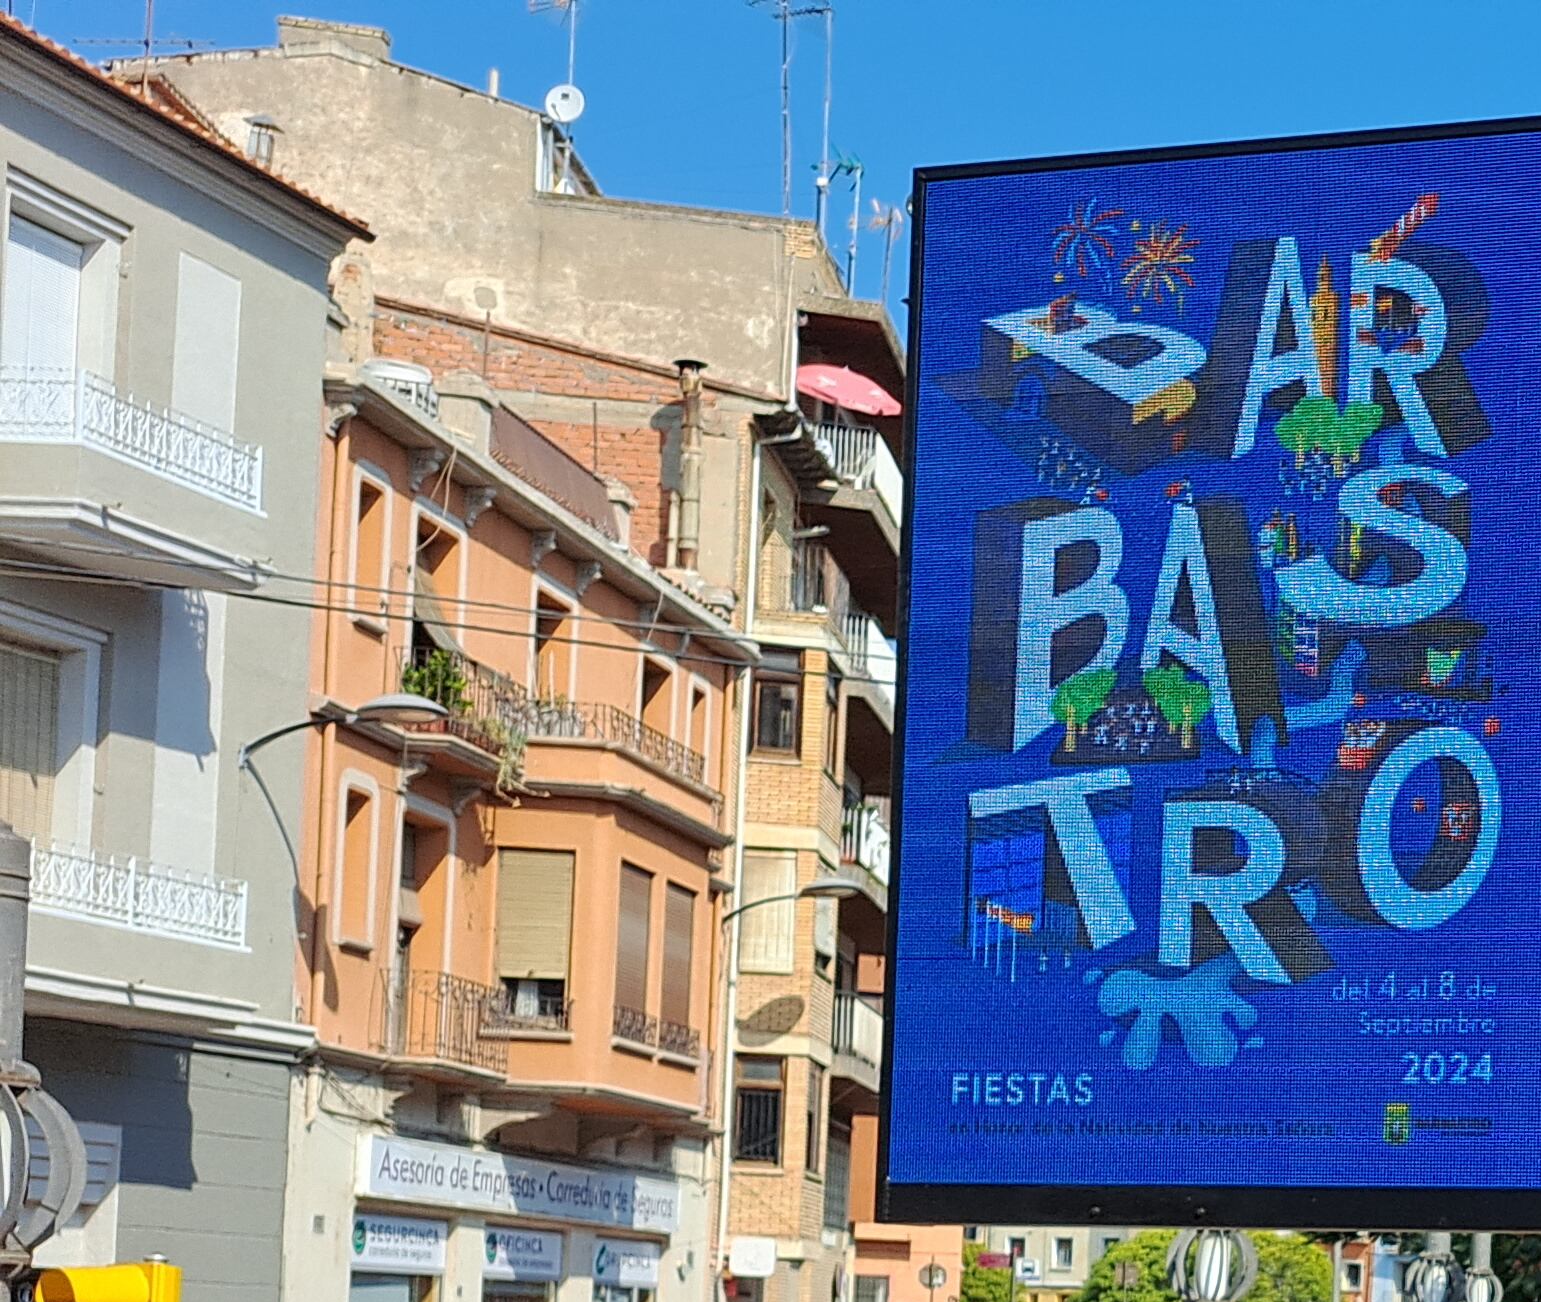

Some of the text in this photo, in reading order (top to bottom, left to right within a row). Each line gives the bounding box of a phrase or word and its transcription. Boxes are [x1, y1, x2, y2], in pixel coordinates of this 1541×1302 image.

[1332, 971, 1497, 1001] del 4 al 8 de
[1358, 1011, 1496, 1039] Septiembre
[1402, 1052, 1494, 1085] 2024
[951, 1072, 1095, 1106] FIESTAS
[378, 1146, 445, 1188] Asesoría
[449, 1155, 468, 1189] de
[472, 1158, 537, 1201] Empresas
